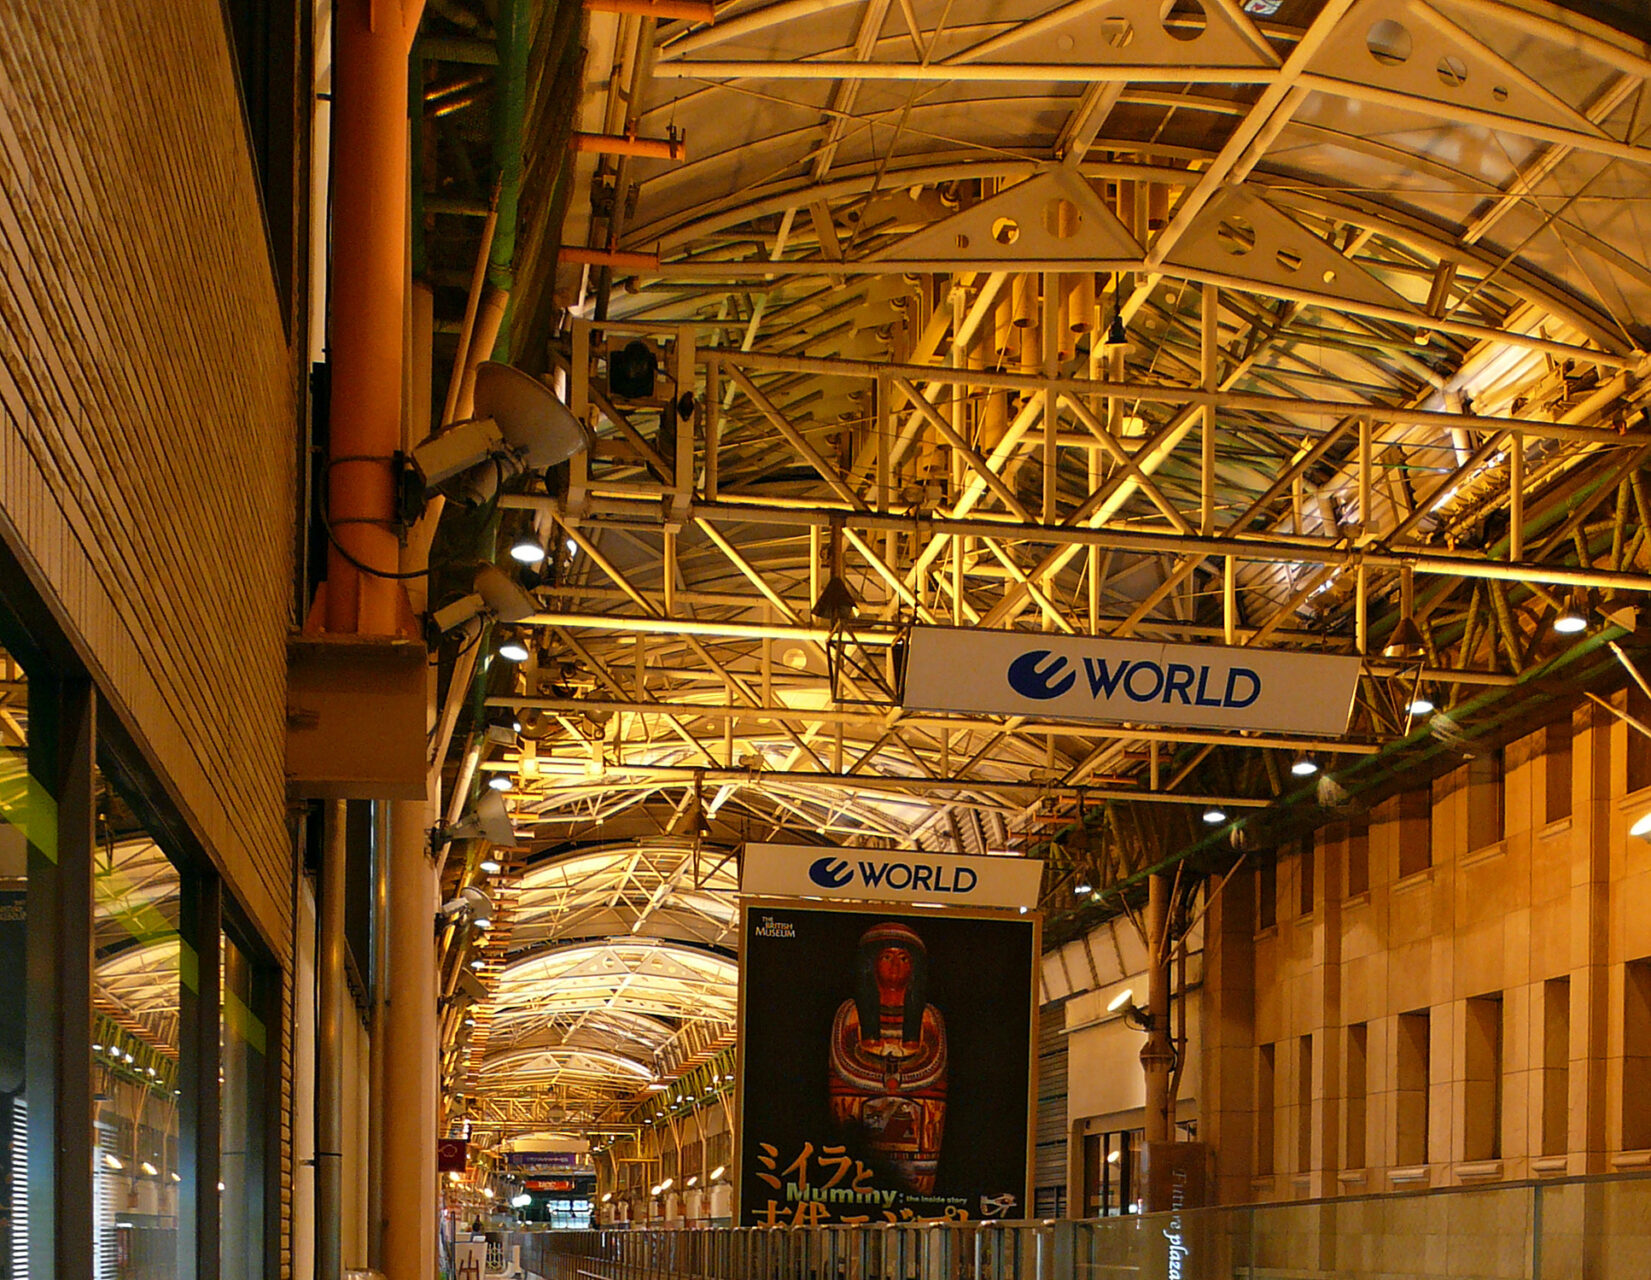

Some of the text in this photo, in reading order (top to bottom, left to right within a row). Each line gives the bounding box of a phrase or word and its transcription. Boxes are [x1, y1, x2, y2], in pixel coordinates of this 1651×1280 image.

[1082, 657, 1262, 708] WORLD
[858, 861, 978, 893] WORLD
[755, 926, 796, 938] MUSEUM
[765, 922, 793, 930] BRITISH
[755, 1141, 875, 1193] ミイラと
[1163, 1229, 1189, 1280] plaza
